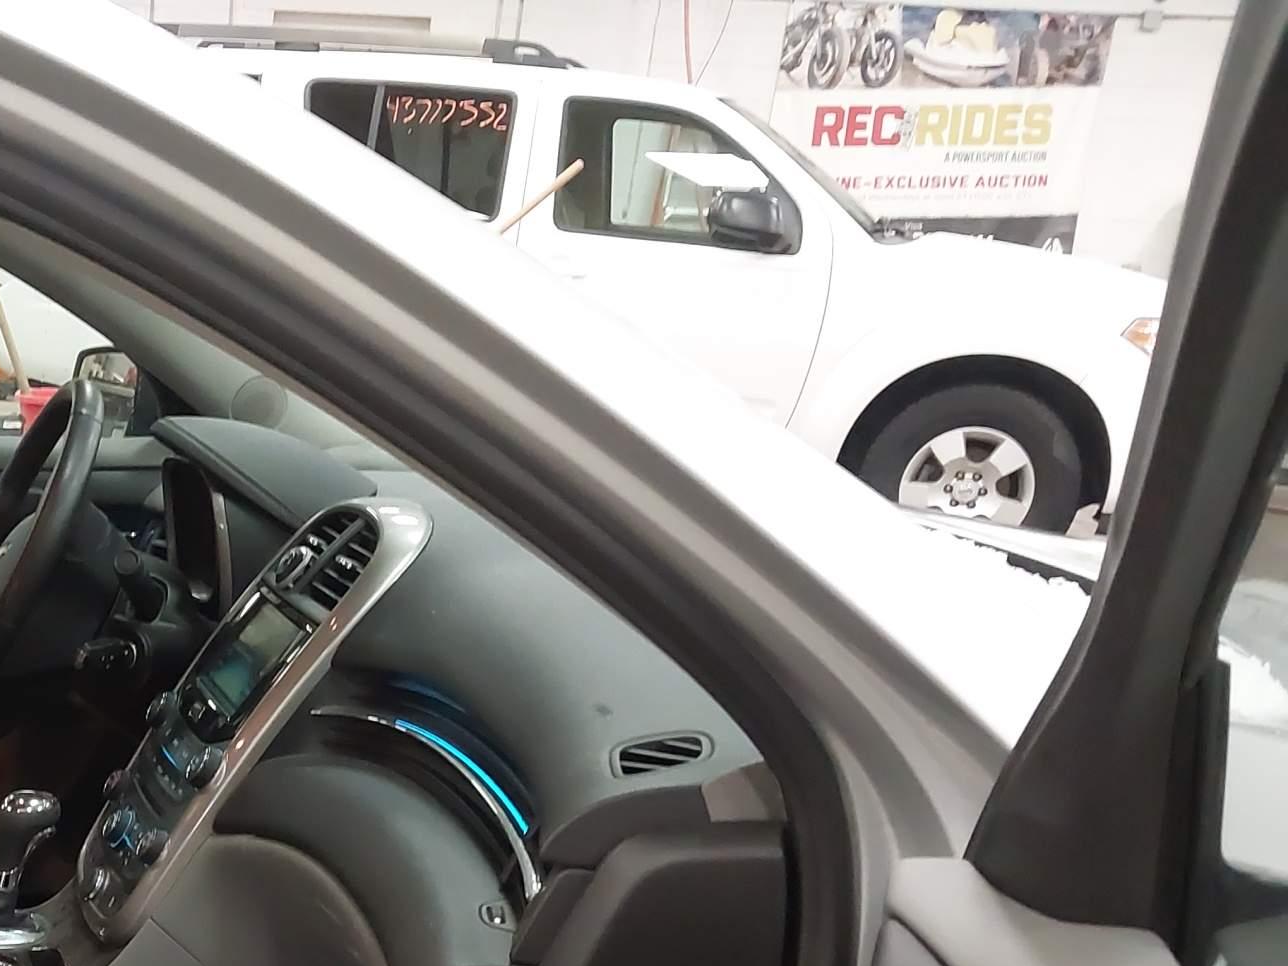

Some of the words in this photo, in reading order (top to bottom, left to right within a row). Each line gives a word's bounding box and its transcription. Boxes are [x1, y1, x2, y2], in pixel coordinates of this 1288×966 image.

[811, 105, 905, 148] REC
[913, 103, 1053, 147] RIDES
[952, 151, 1008, 164] POWERSPORT
[1010, 151, 1047, 162] AUCTION
[975, 174, 1048, 189] AUCTION
